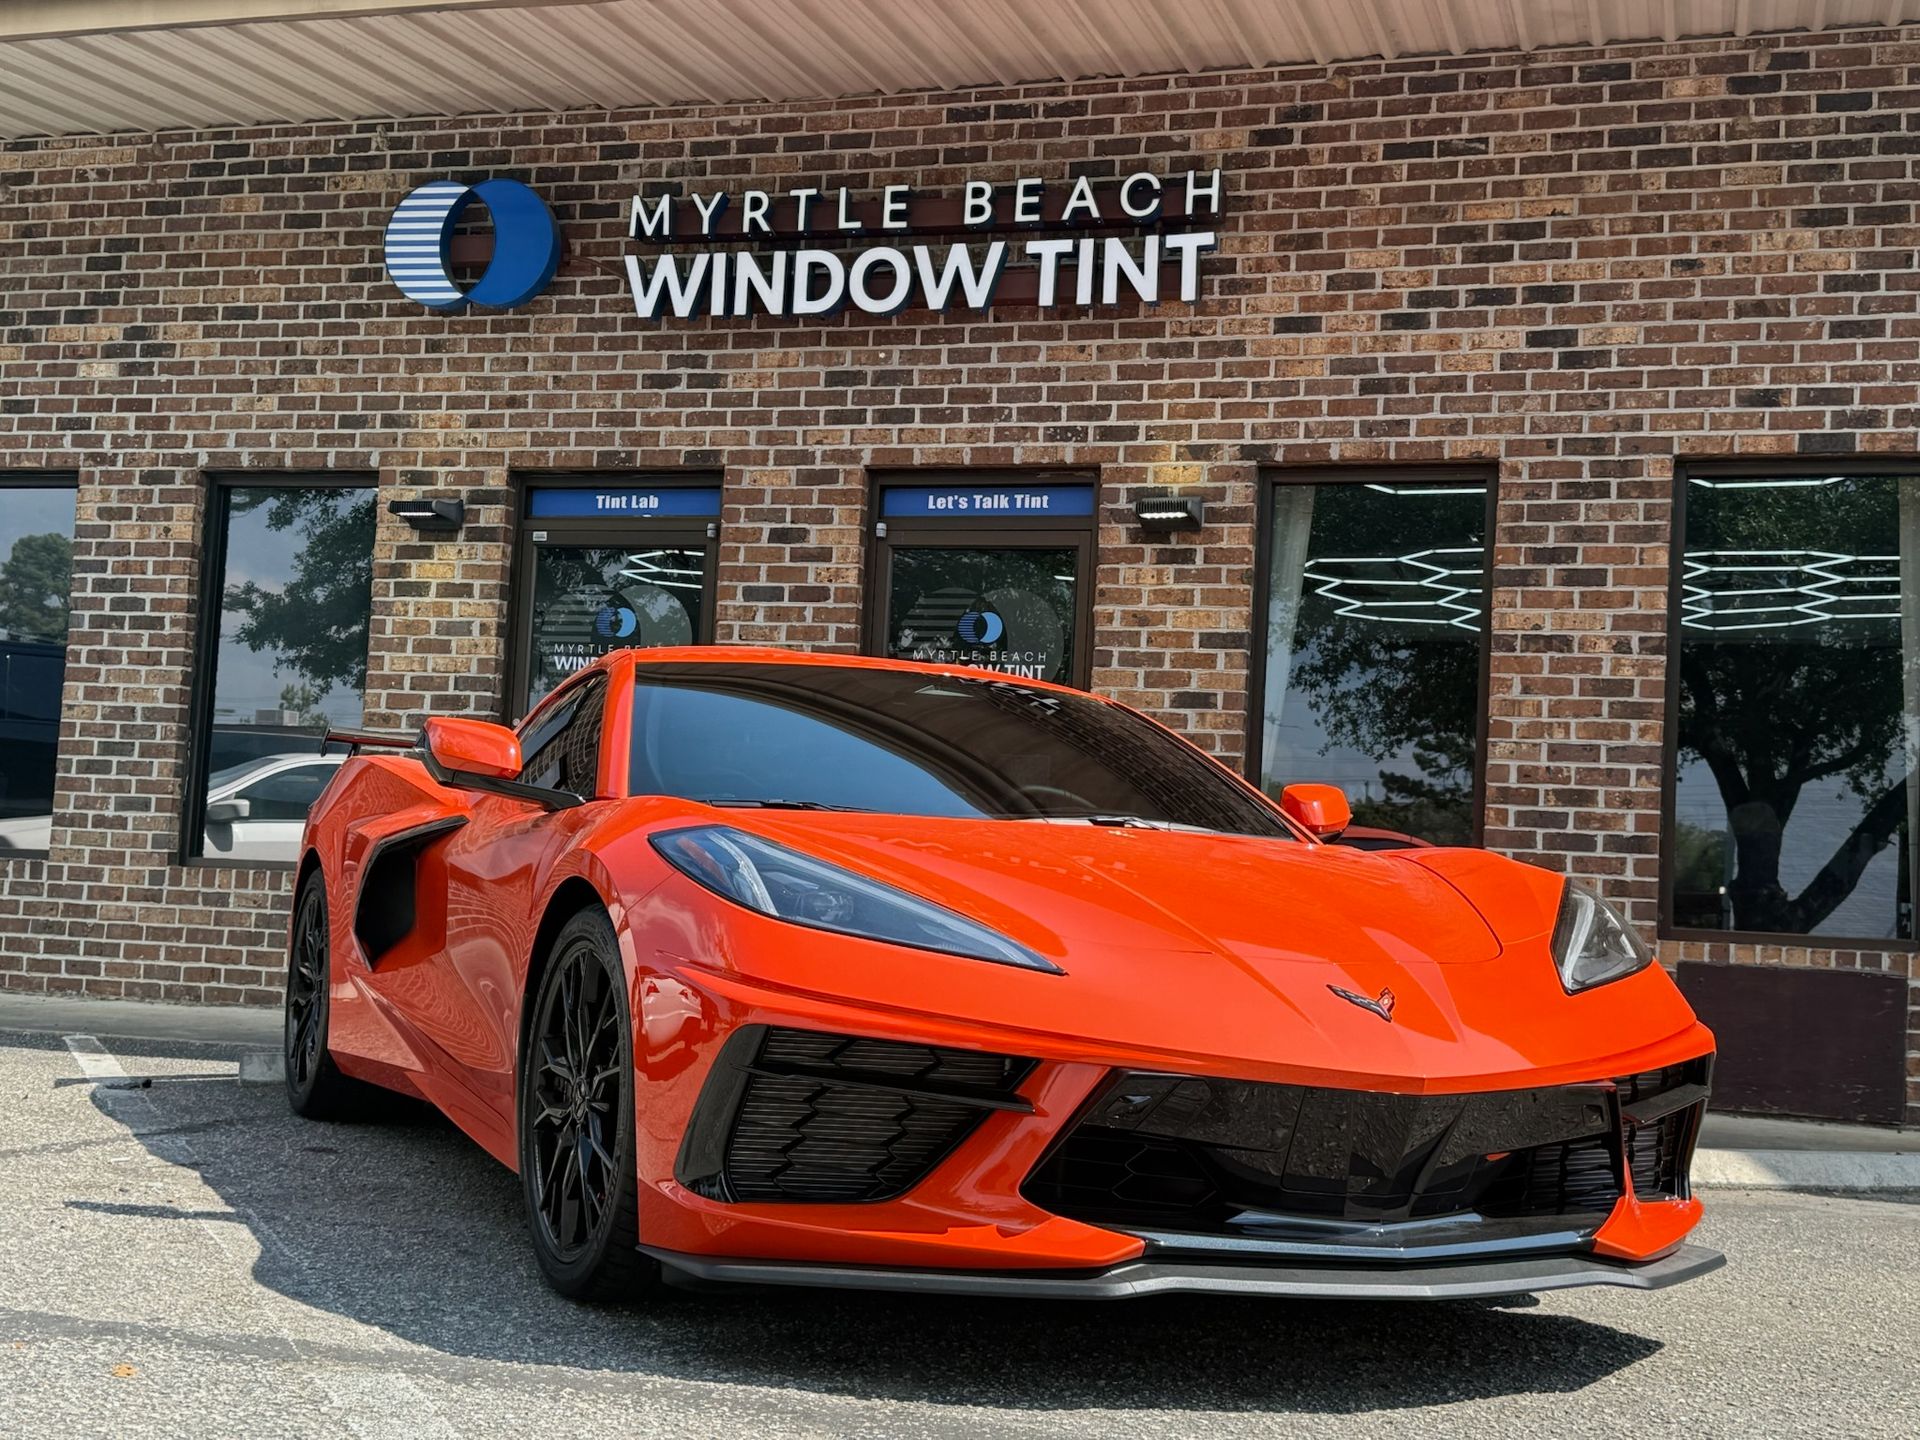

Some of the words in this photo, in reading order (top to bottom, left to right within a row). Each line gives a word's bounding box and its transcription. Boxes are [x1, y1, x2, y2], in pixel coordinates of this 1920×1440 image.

[629, 184, 910, 238] MYRTLE
[963, 168, 1221, 226] BEACH
[624, 241, 1006, 318] WINDOW
[1025, 231, 1216, 308] TINT
[596, 495, 628, 509] Tint
[631, 494, 659, 509] Lab
[927, 495, 968, 509] Let's
[973, 494, 1010, 509] Talk
[1014, 494, 1049, 509] Tint
[553, 643, 615, 655] MYRTLE
[912, 649, 979, 660] MYRTLE
[990, 650, 1047, 662] BEACH
